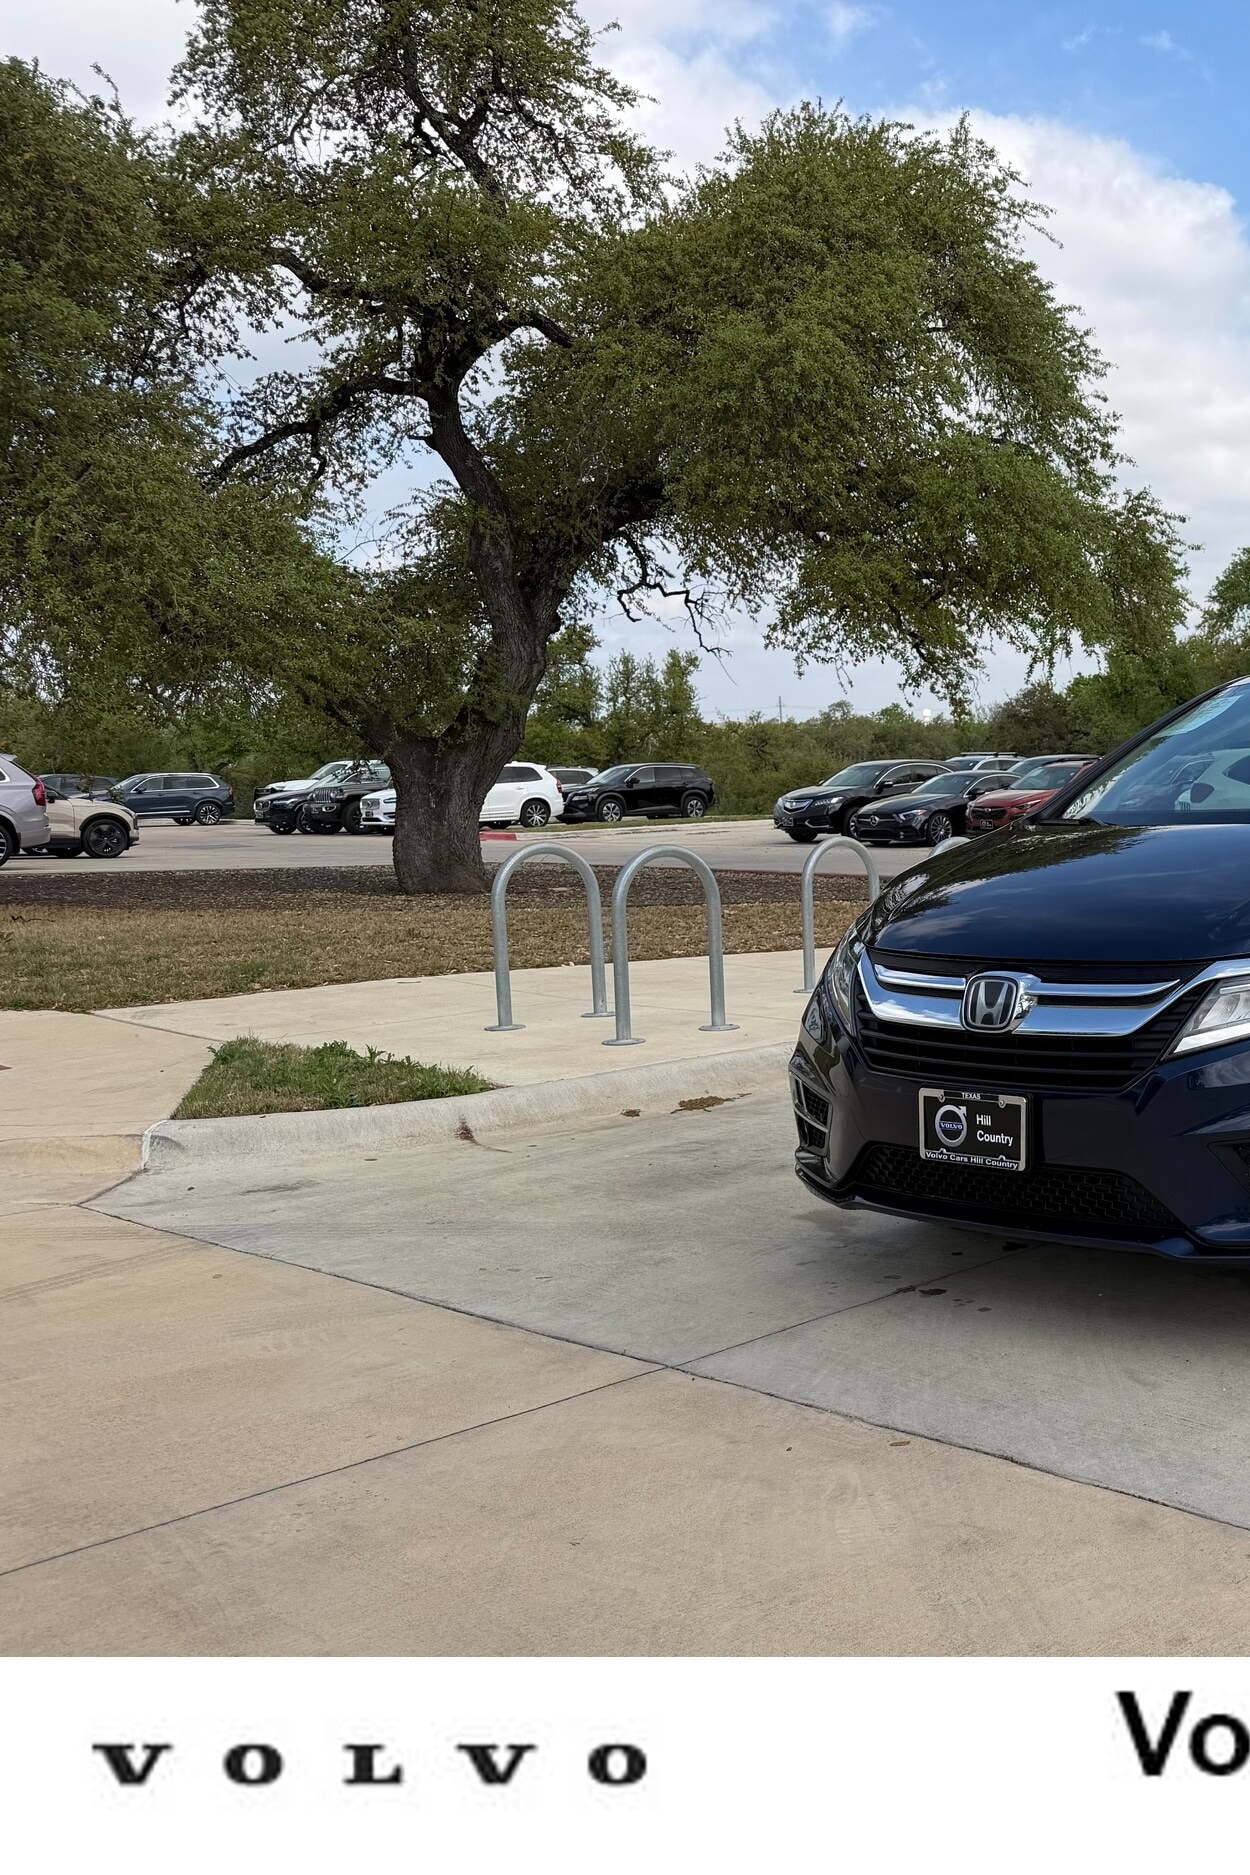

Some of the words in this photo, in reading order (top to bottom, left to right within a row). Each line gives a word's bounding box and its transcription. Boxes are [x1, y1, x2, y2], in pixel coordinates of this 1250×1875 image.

[961, 1092, 981, 1100] TEXAS
[976, 1114, 992, 1126] Hill
[977, 1130, 1013, 1146] Country
[926, 1151, 948, 1160] Volvo
[949, 1154, 968, 1163] Cars
[970, 1156, 984, 1165] Hill
[985, 1158, 1018, 1170] Country
